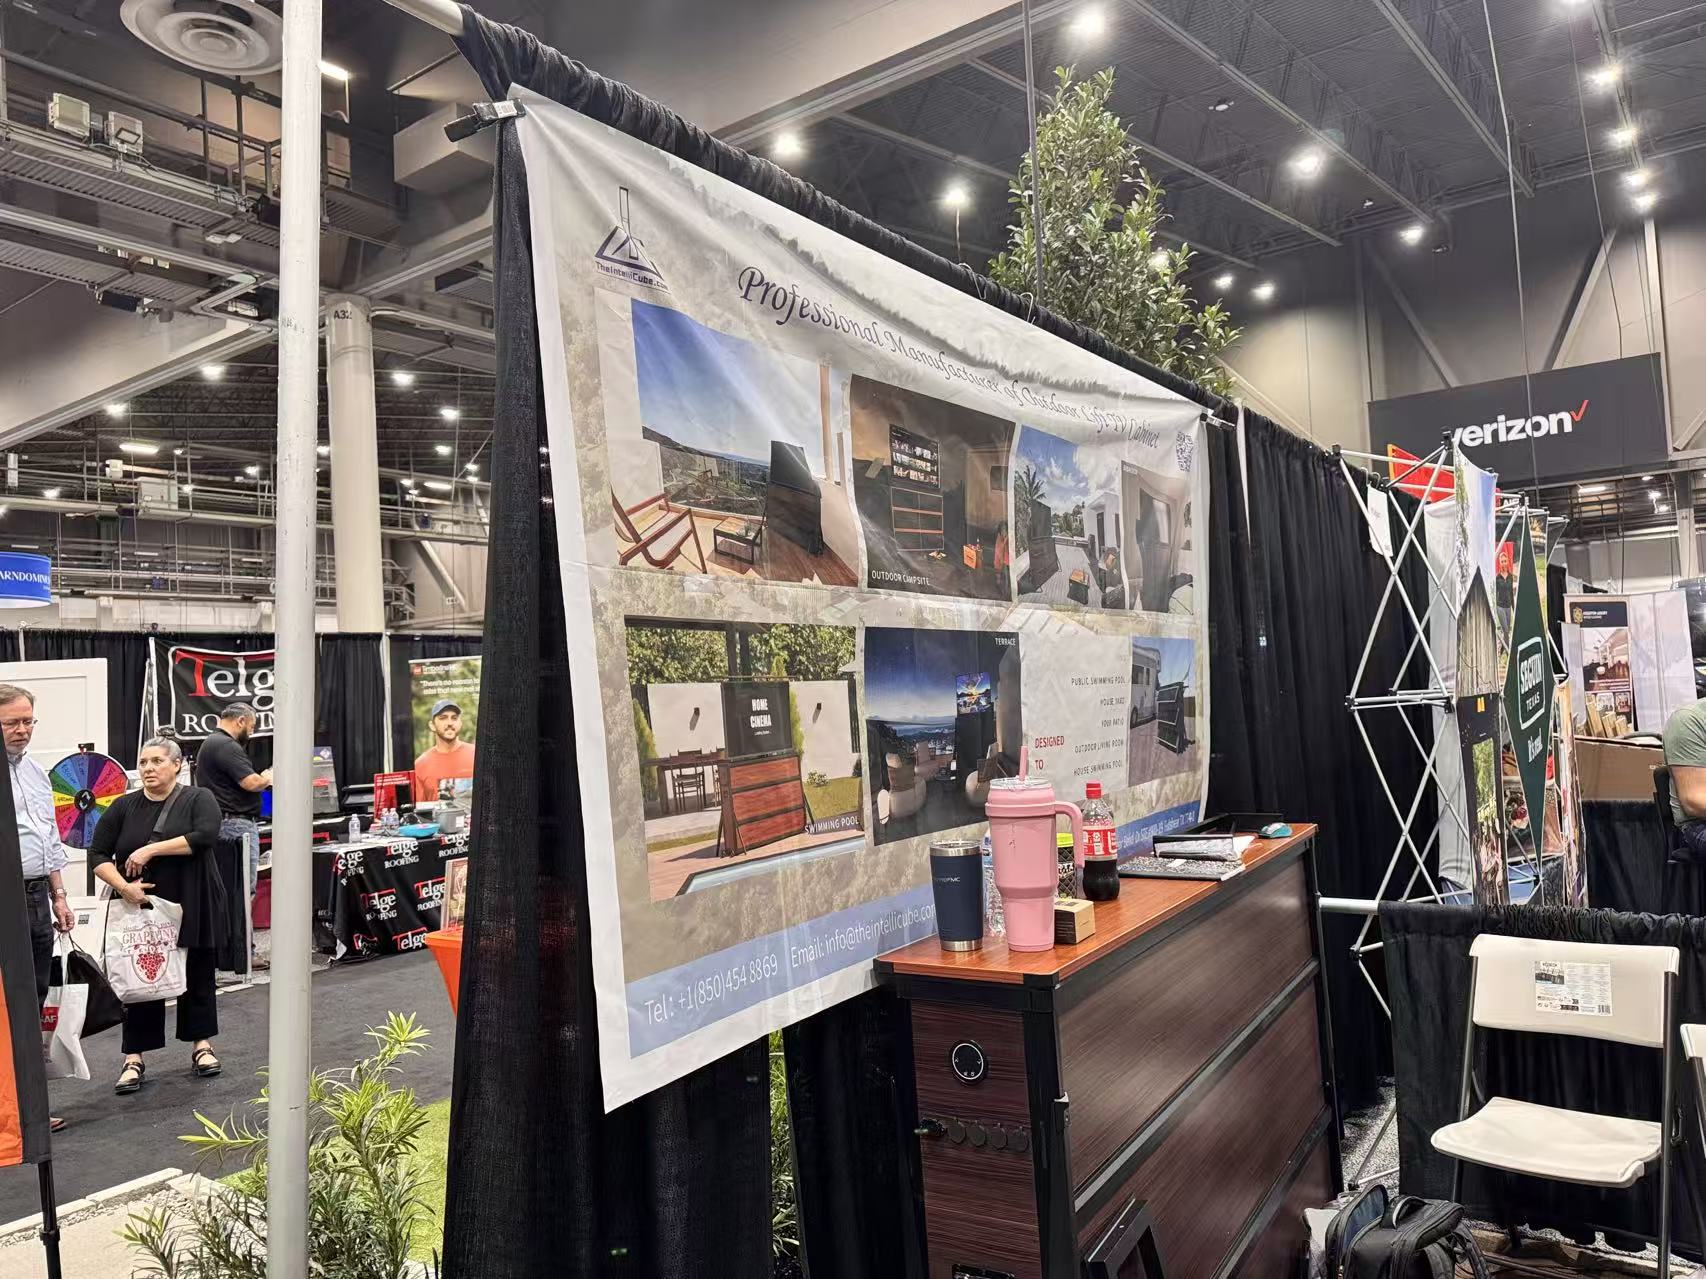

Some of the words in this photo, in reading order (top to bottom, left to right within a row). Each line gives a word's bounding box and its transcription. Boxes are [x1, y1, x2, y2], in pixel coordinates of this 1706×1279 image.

[738, 266, 884, 348] Professional
[884, 330, 1002, 395] Manufacturer
[1003, 378, 1024, 407] of
[1021, 385, 1081, 419] Outdoor
[1127, 418, 1161, 449] Cabinet
[1451, 410, 1573, 448] verizon
[871, 570, 902, 582] OUTDOOR
[902, 574, 931, 586] CAMPSITE
[994, 637, 1016, 646] TERRACE
[174, 649, 275, 711] Telg
[1071, 677, 1089, 686] PUBLIC
[1520, 652, 1543, 695] SEGUIN
[751, 698, 769, 712] HOME
[1525, 691, 1541, 713] TEXAS
[750, 713, 772, 729] CINEMA
[1101, 719, 1112, 728] YOUR
[1112, 717, 1125, 727] PATIO
[1034, 735, 1065, 749] DESIGNED
[1074, 742, 1097, 754] OUTDOOR
[1097, 739, 1111, 752] LIVING
[1111, 737, 1124, 748] ROOM
[1034, 759, 1044, 770] TO
[1073, 765, 1090, 776] HOUSE
[1112, 759, 1123, 768] POOL
[804, 818, 840, 834] SWIMMING
[840, 816, 860, 828] POOL
[384, 854, 420, 870] ROOFING
[414, 876, 446, 901] Telge
[360, 887, 397, 914] Telge
[122, 927, 178, 946] GRAPEVINE
[790, 937, 825, 968] Email:
[748, 953, 778, 983] 8869
